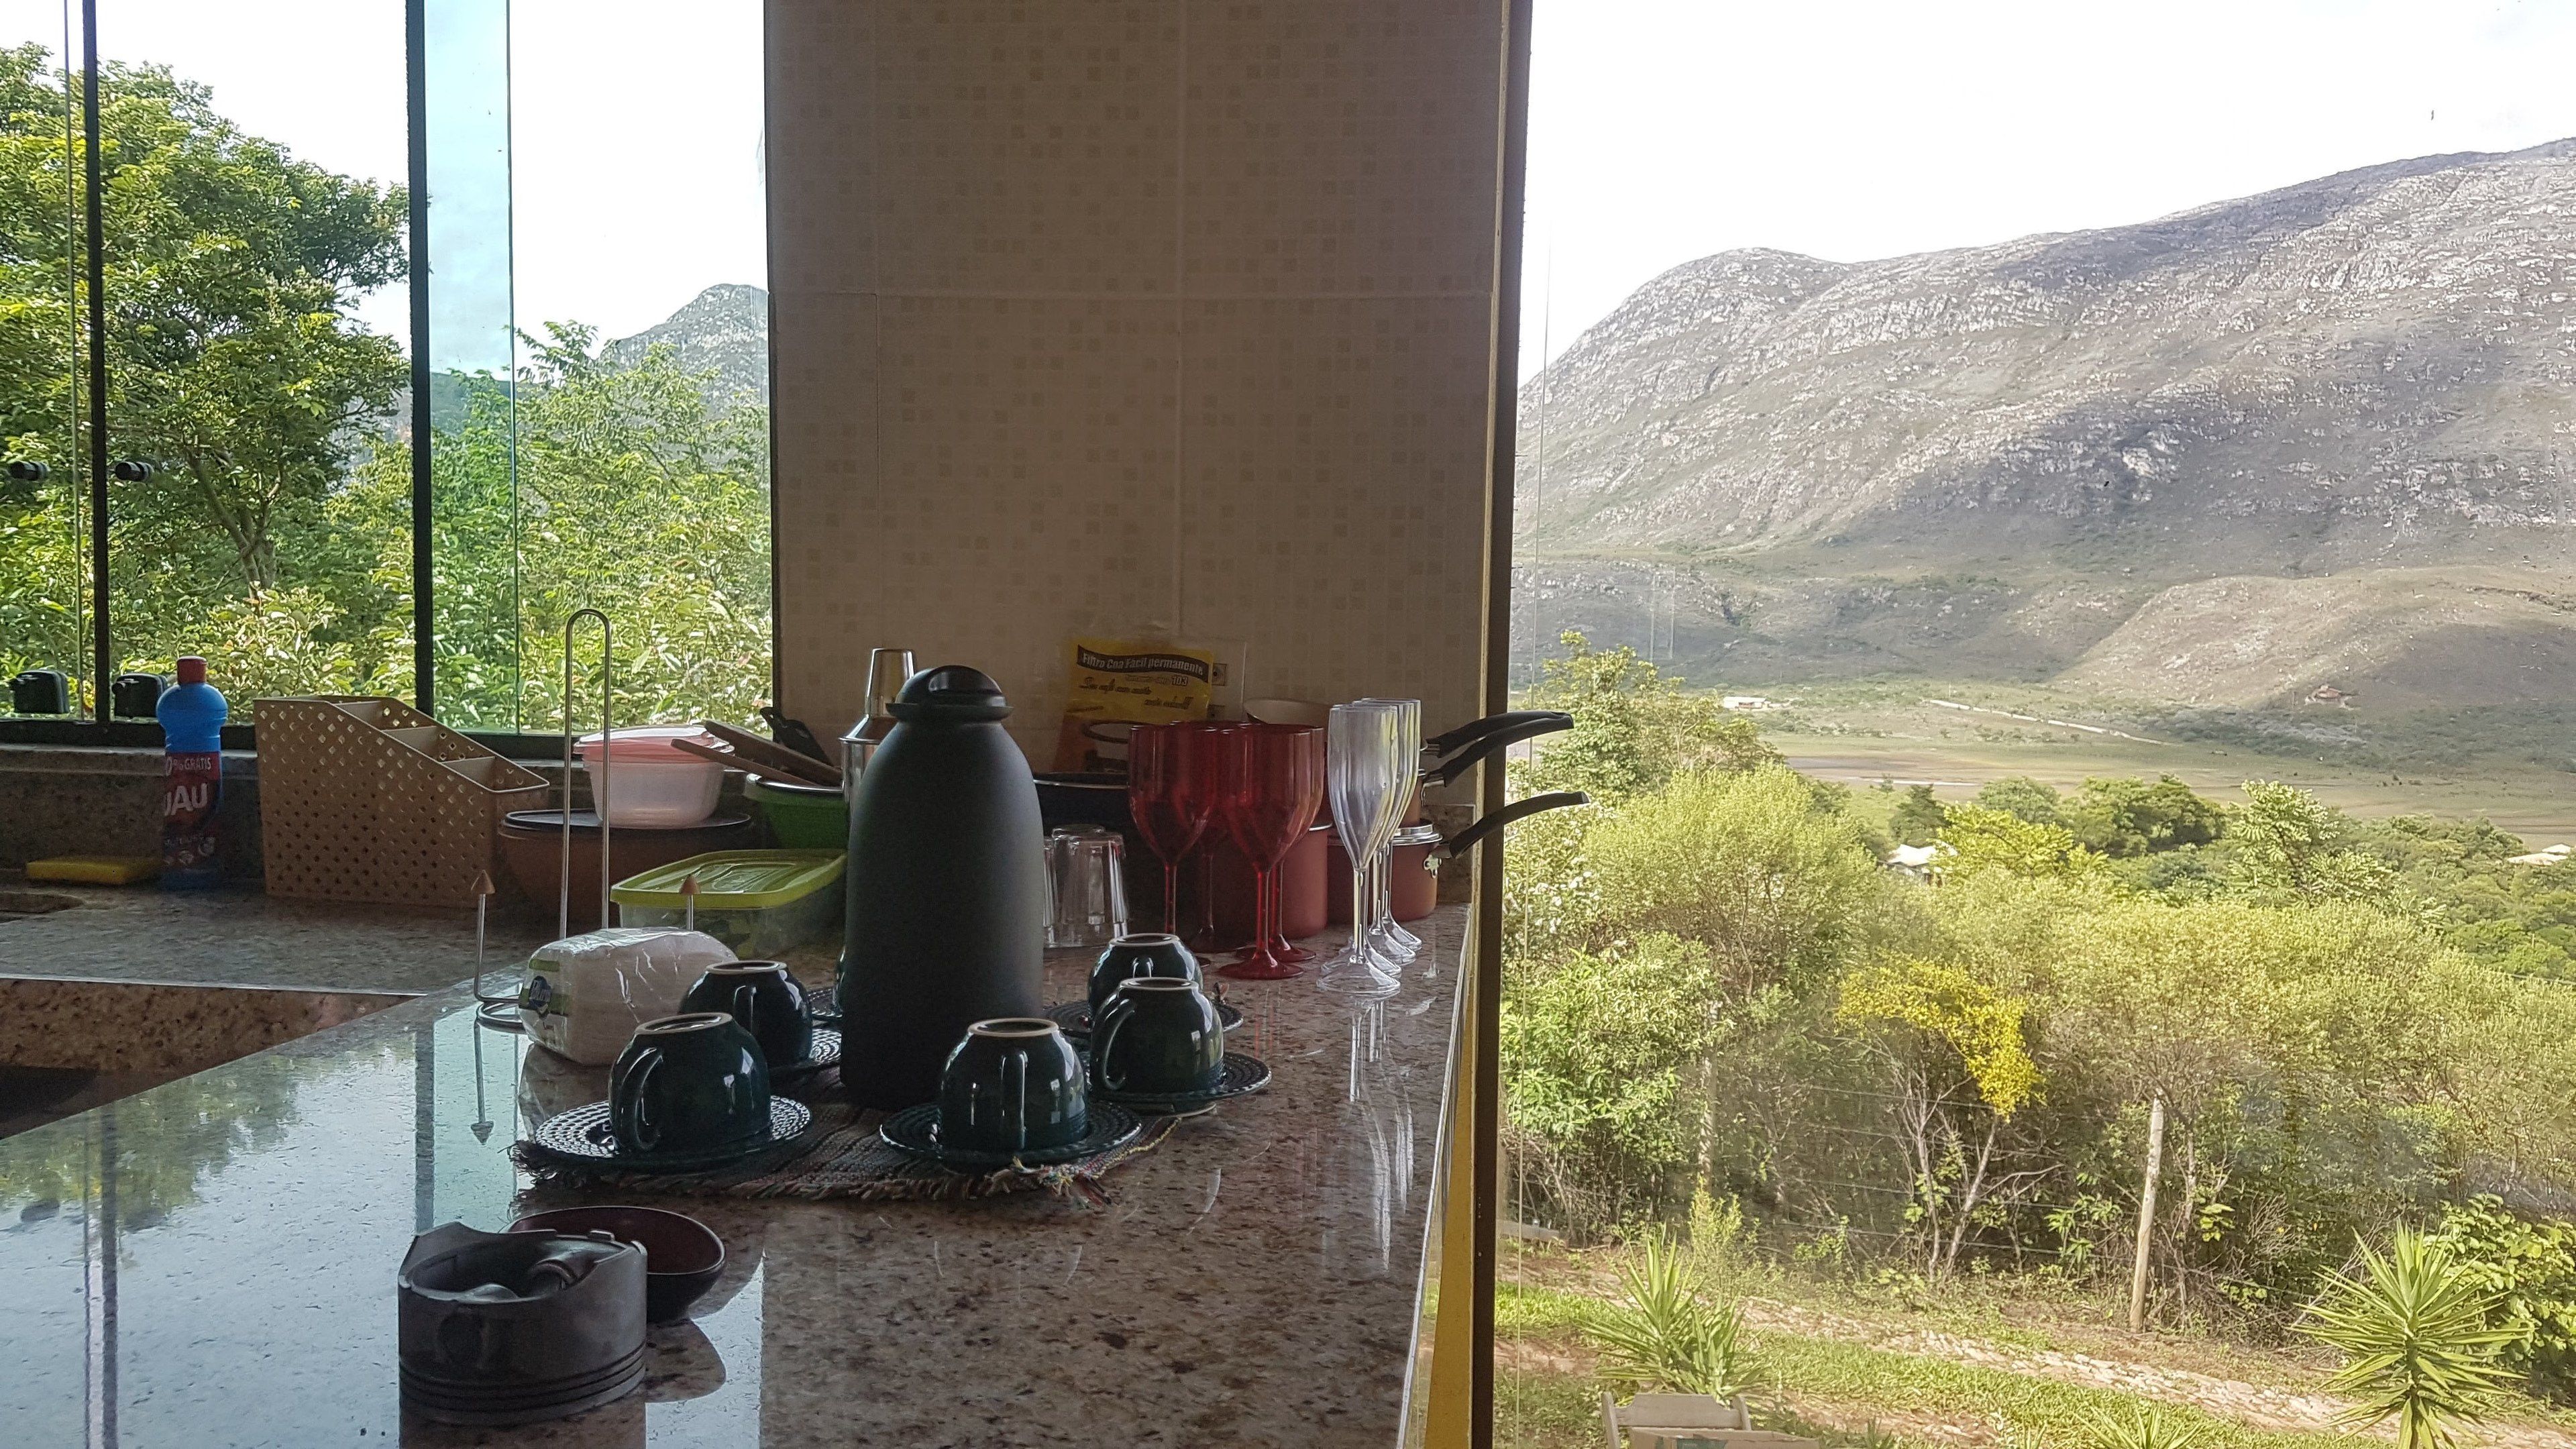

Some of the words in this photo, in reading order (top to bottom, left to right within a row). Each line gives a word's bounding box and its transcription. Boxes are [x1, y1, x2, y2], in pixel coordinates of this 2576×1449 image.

[1083, 653, 1106, 668] Filtro
[1148, 657, 1203, 676] permanente
[1172, 676, 1188, 686] 103
